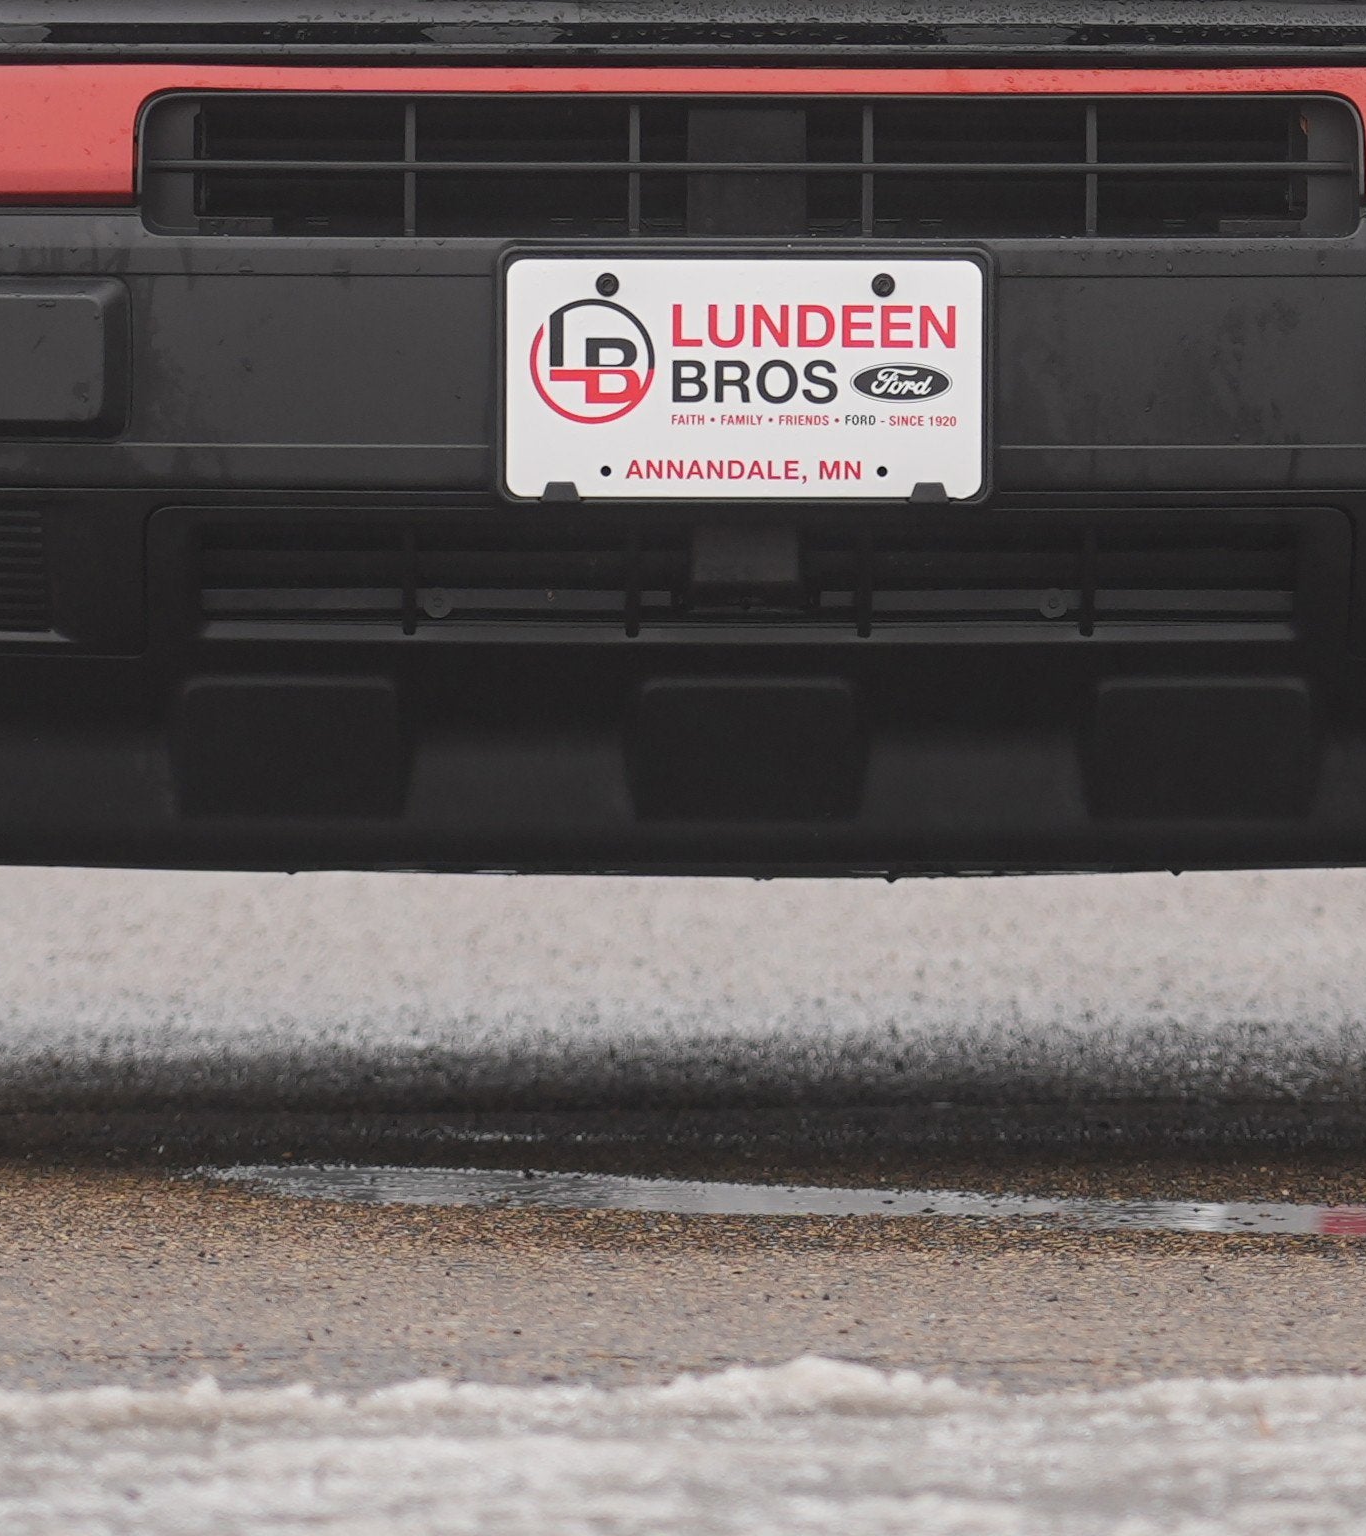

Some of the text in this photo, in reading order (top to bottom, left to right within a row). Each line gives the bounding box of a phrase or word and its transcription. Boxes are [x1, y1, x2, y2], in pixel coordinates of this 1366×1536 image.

[671, 303, 957, 349] LUNDEEN
[671, 359, 839, 405] BROS
[869, 366, 934, 397] Ford
[671, 414, 957, 428] FAITH FAMILY FRIENDS FORD SINCE 1920
[625, 459, 862, 484] ANNANDALE, MN
